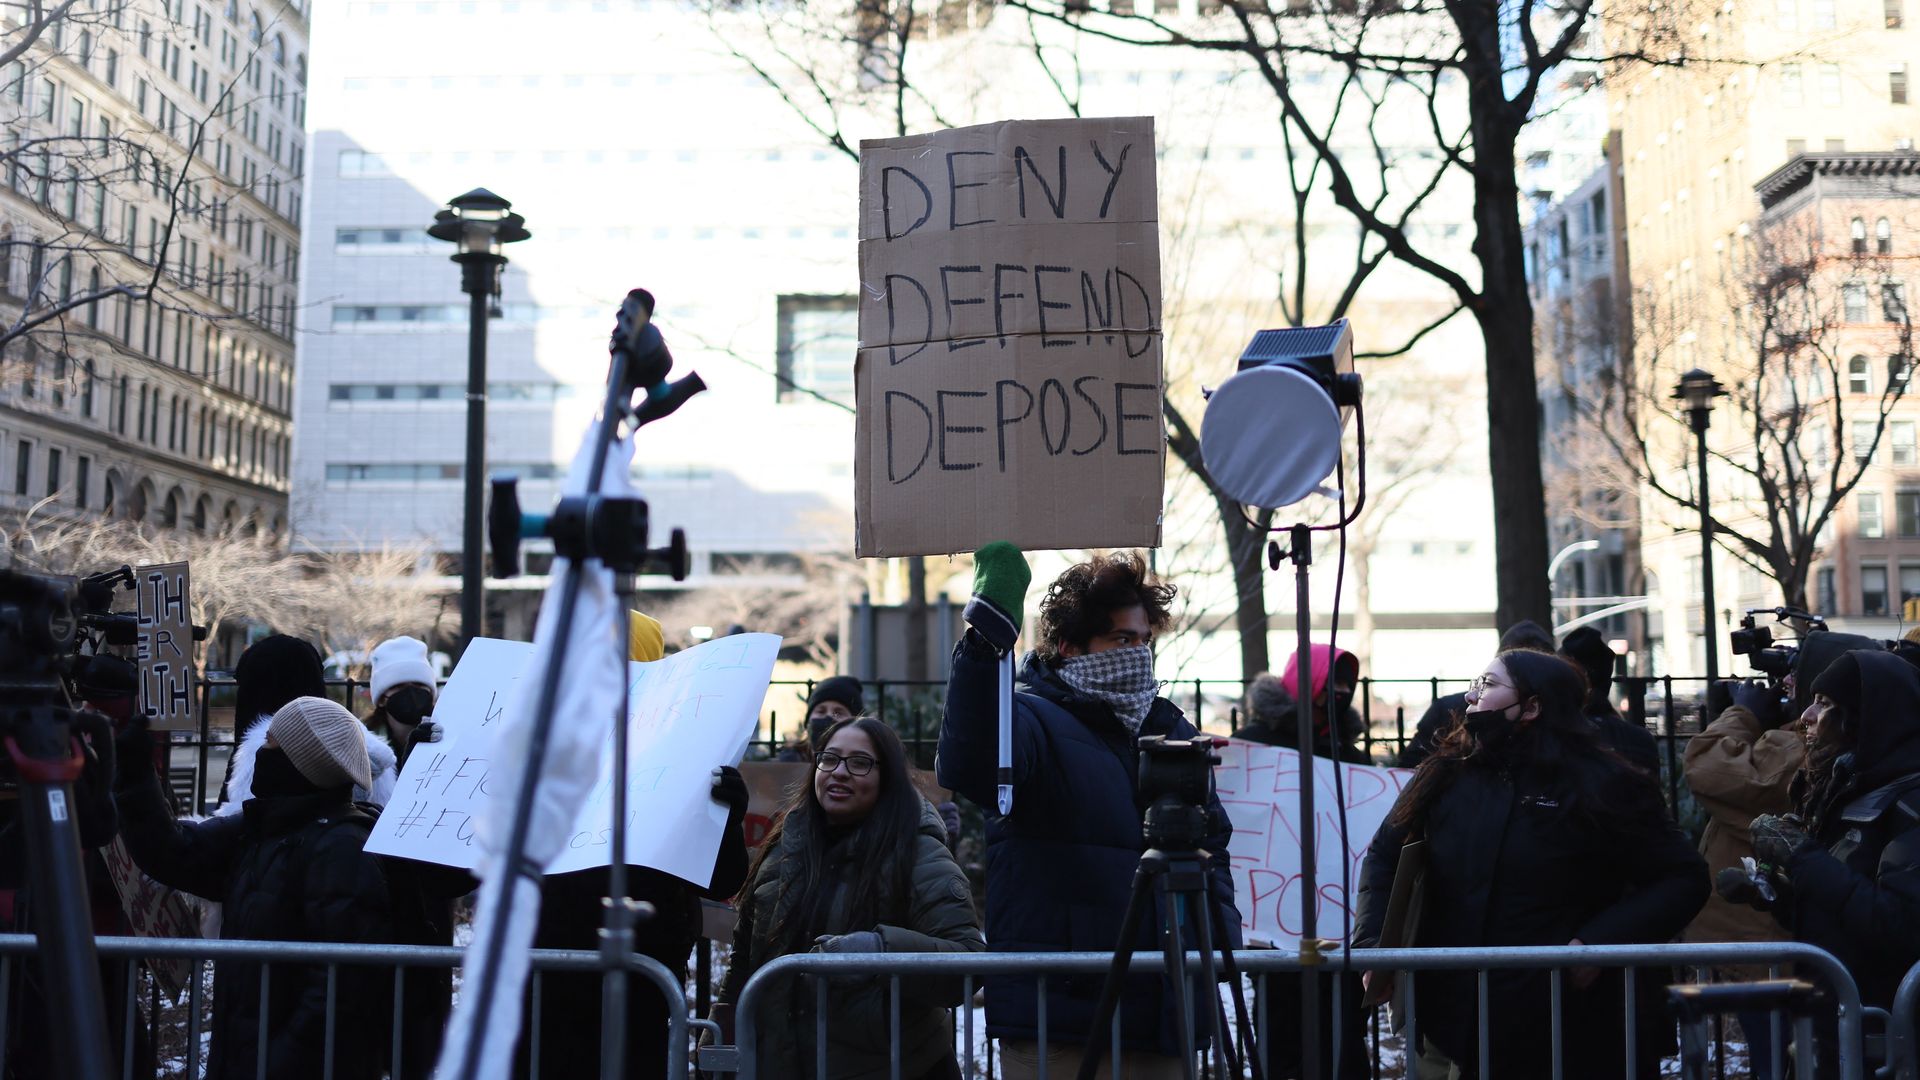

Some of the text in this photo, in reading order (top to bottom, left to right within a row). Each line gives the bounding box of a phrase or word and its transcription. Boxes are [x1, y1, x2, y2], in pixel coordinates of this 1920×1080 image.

[882, 140, 1132, 242] DENY
[885, 263, 1155, 365] DEFEND
[885, 375, 1158, 485] DEPOSE
[136, 572, 186, 627] LTH
[137, 630, 183, 661] ER
[141, 662, 191, 721] LTH
[416, 752, 489, 800] #FR
[394, 801, 475, 847] #FU
[1219, 800, 1373, 894] ENY
